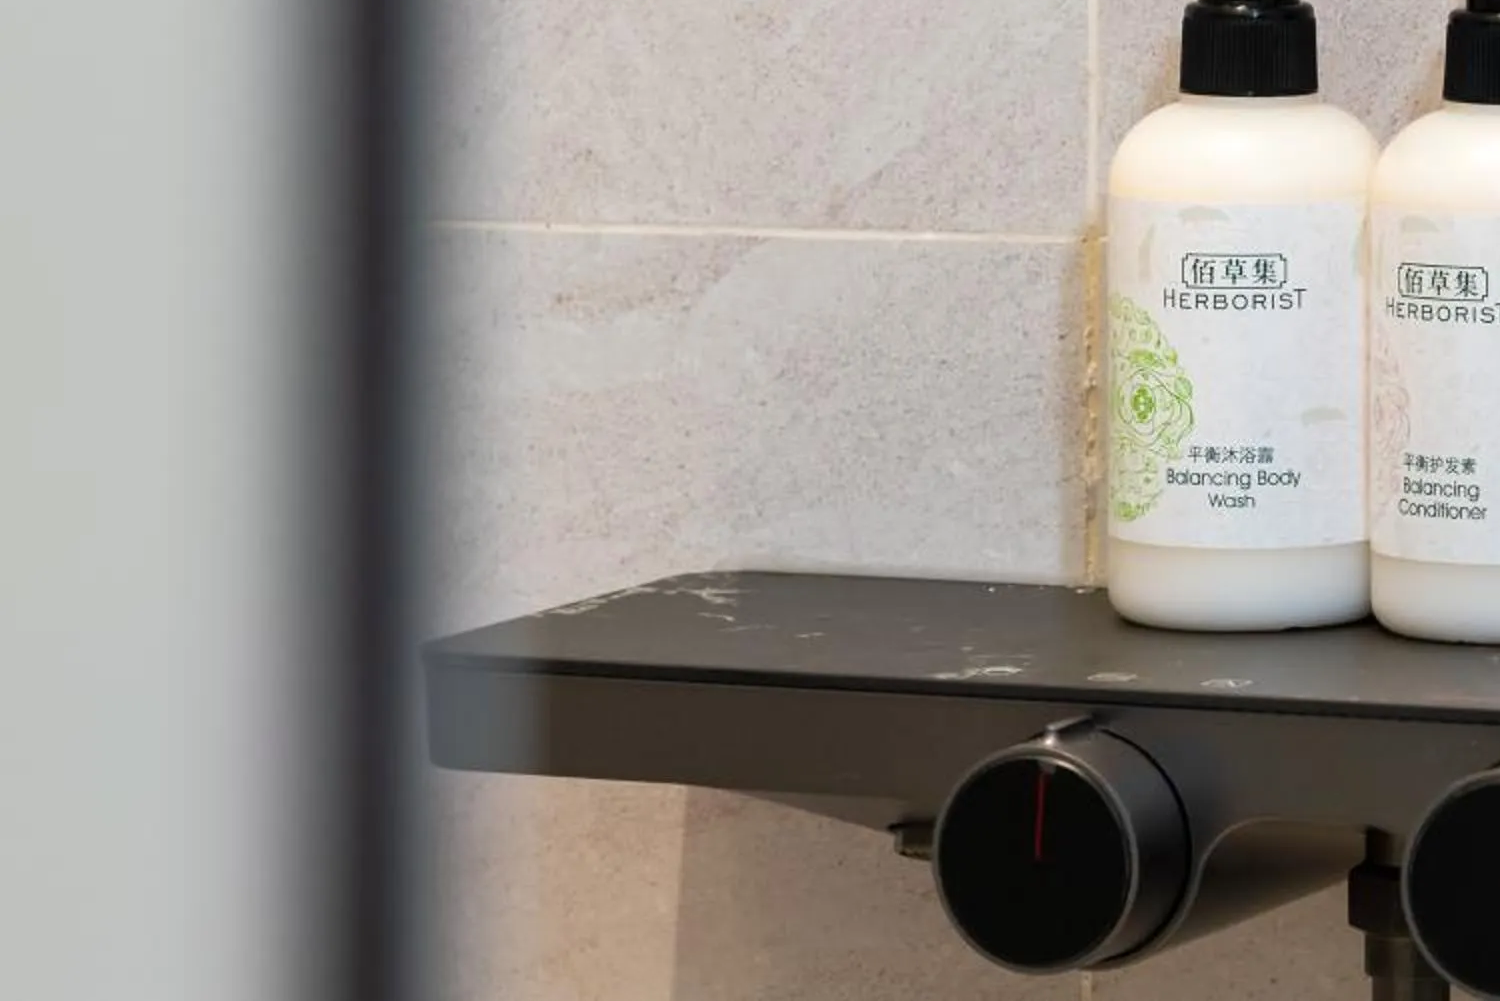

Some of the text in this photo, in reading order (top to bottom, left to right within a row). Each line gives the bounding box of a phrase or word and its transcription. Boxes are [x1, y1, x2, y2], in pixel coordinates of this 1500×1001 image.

[1191, 257, 1278, 285] 佰草集
[1403, 267, 1480, 298] 佰草集
[1163, 288, 1307, 310] HERBORIST
[1166, 468, 1301, 490] Balancing Body
[1403, 476, 1481, 502] Balancing
[1207, 492, 1256, 508] Wash
[1397, 497, 1488, 520] Conditioner
